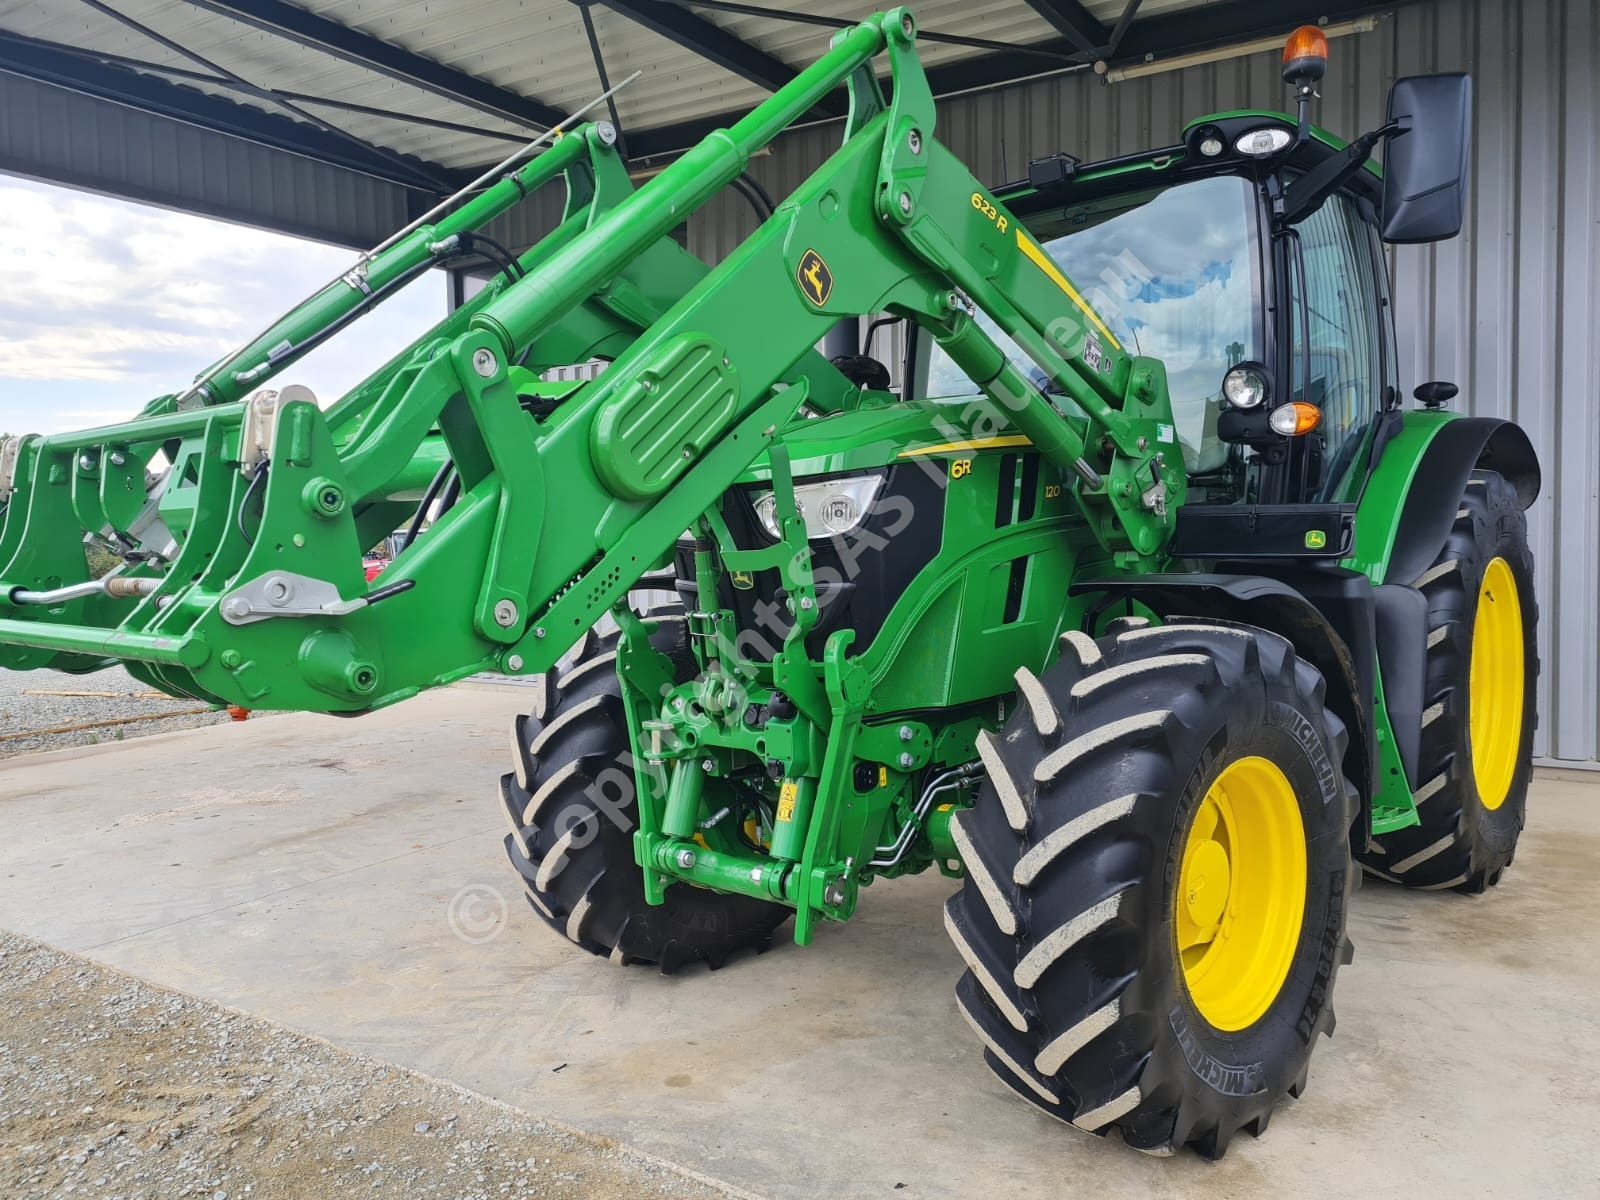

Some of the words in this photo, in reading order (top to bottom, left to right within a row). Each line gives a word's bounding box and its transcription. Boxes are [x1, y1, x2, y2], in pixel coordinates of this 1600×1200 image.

[970, 192, 997, 222] 623
[996, 214, 1009, 234] R
[951, 459, 972, 480] 6R
[1044, 484, 1061, 499] 120
[1284, 705, 1337, 799] MICHELIN
